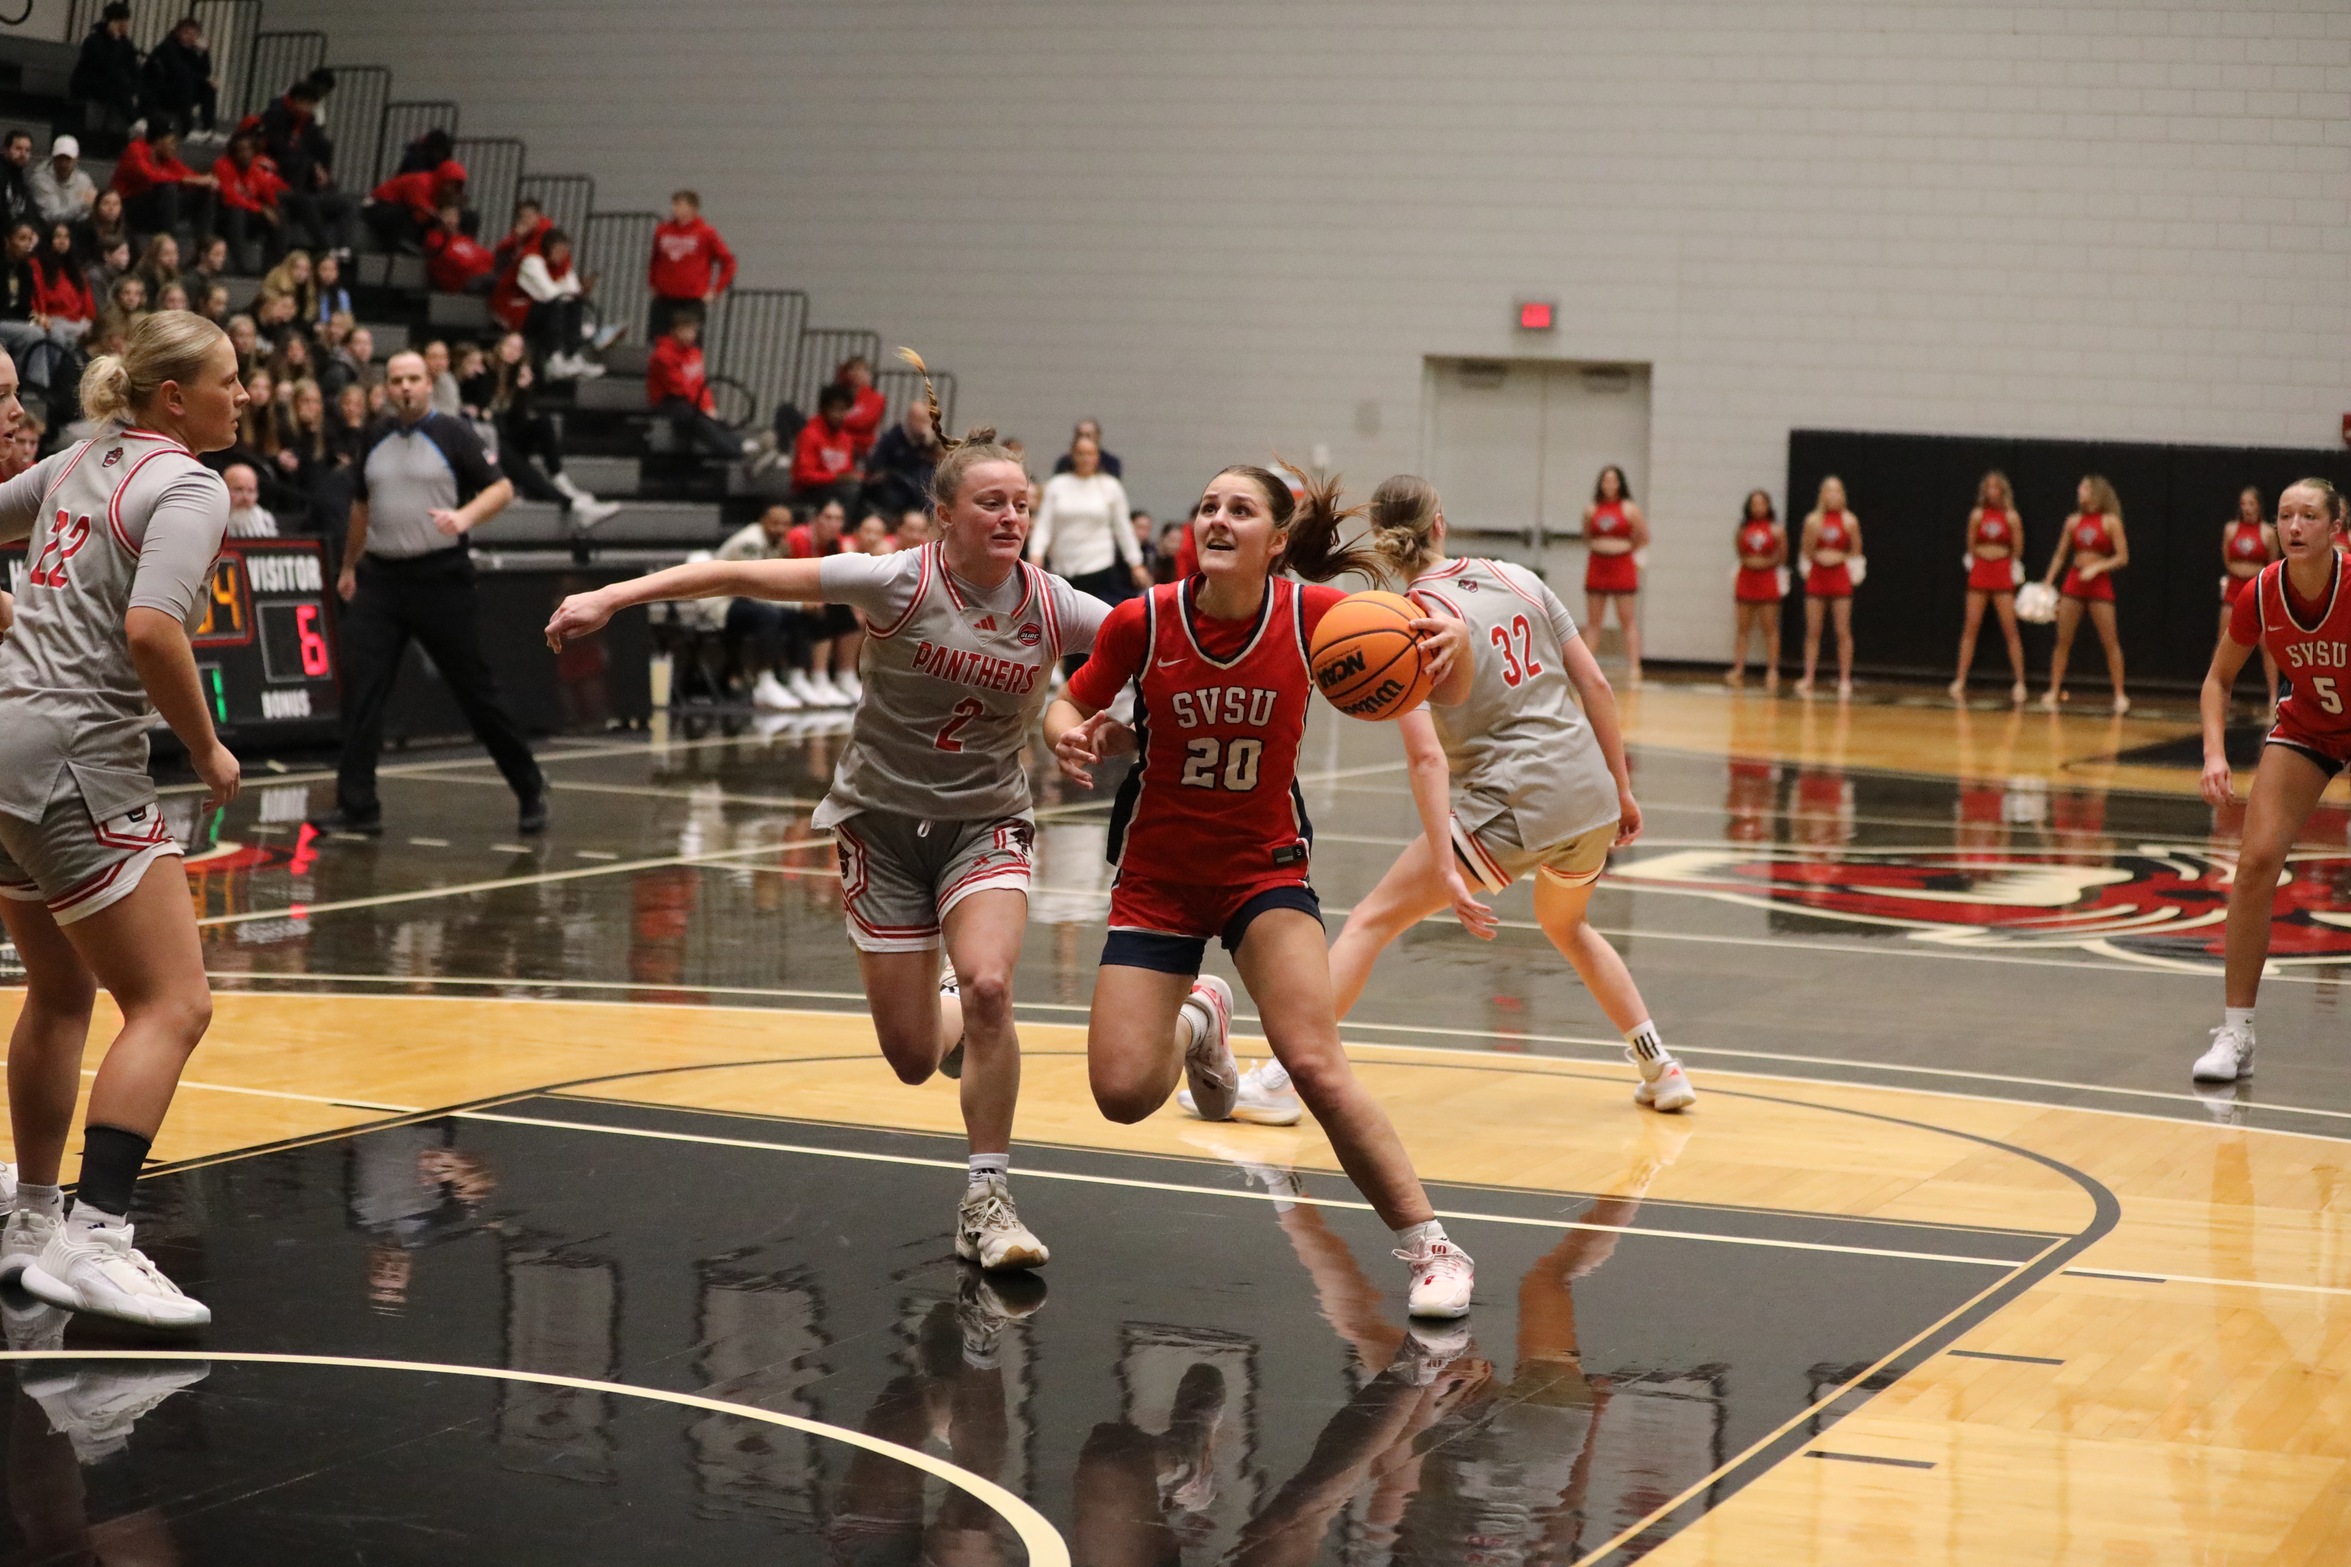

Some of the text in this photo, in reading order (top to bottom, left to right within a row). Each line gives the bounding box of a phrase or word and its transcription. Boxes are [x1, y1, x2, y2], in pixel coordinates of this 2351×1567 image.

[30, 508, 91, 591] 22
[246, 555, 323, 592] VISITOR
[197, 566, 241, 635] 4
[296, 604, 329, 676] 6
[1489, 612, 1544, 690] 32
[2285, 640, 2347, 668] SVSU
[911, 641, 1041, 695] PANTHERS
[2312, 676, 2343, 714] 5
[933, 696, 984, 753] 2
[1172, 686, 1278, 729] SVSU
[1180, 737, 1262, 791] 20
